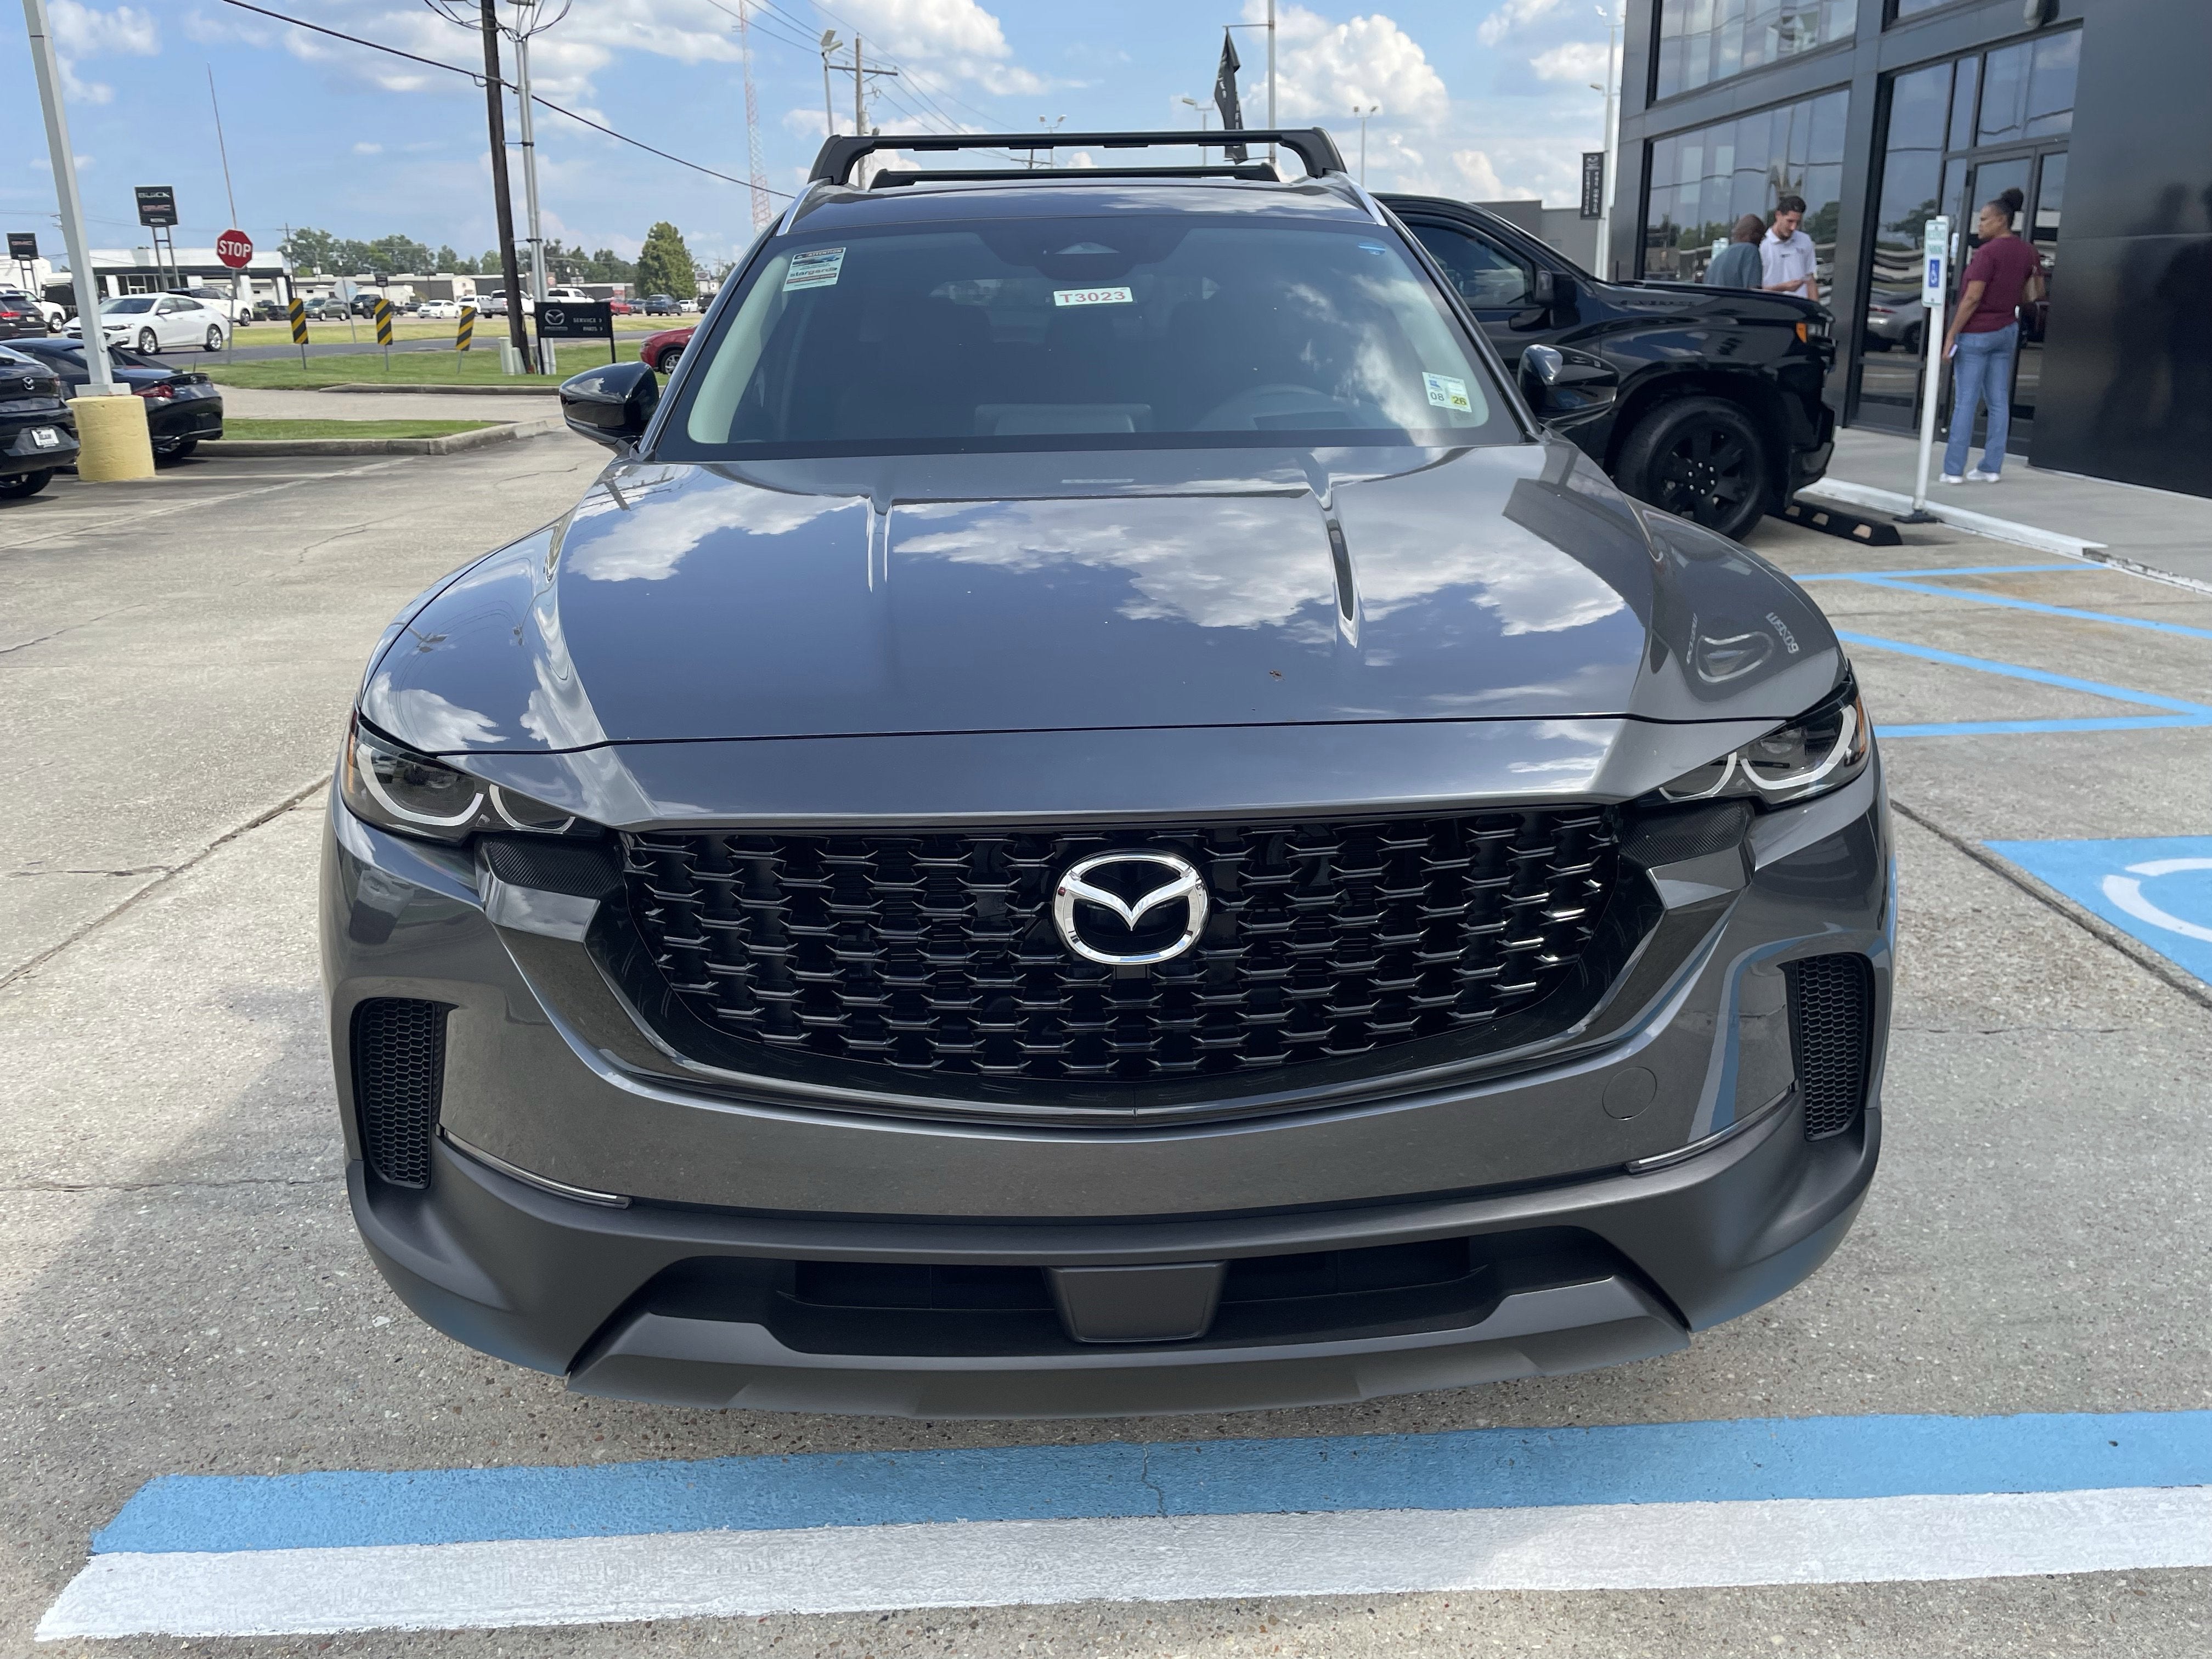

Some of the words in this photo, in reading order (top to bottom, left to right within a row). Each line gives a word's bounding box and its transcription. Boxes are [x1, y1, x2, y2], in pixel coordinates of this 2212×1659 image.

[219, 240, 251, 258] STOP
[808, 249, 842, 257] ATTENTION
[1059, 291, 1126, 303] T3023
[1430, 392, 1444, 402] 08
[1452, 396, 1468, 406] 26
